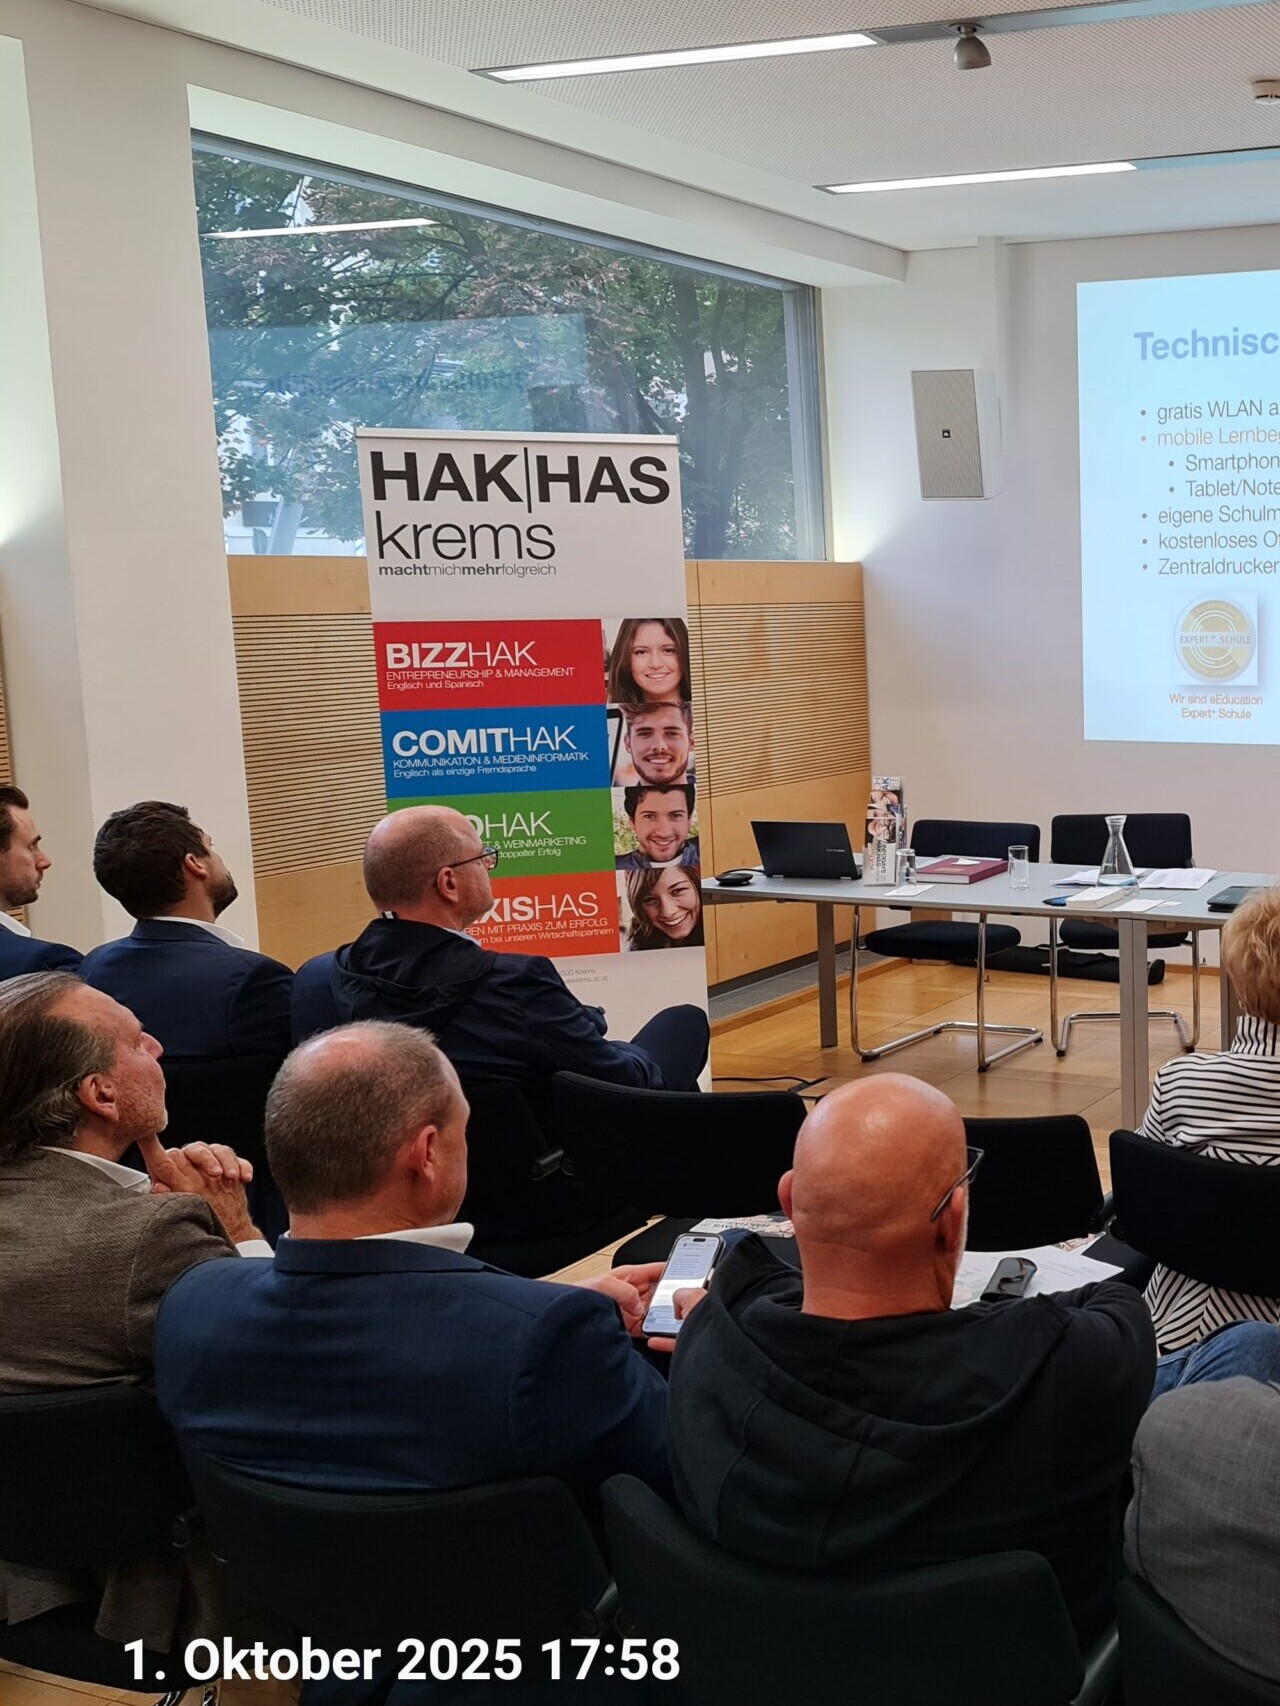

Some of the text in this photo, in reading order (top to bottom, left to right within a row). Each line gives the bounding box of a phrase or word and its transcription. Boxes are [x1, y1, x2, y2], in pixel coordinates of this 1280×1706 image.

[1157, 403, 1202, 424] gratis
[1208, 399, 1263, 418] WLAN
[1157, 427, 1213, 447] mobile
[1158, 505, 1214, 527] eigene
[375, 510, 556, 560] krems
[1159, 530, 1258, 550] kostenloses
[378, 564, 557, 578] machtmichmehrfolgreich
[1159, 556, 1280, 576] Zentraldrucker
[1180, 635, 1208, 644] EXPERT
[1219, 635, 1251, 644] SCHULE
[386, 641, 538, 669] BIZZHAK
[386, 667, 575, 681] ENTREPRENEURSHIP & MANAGEMENT
[387, 680, 484, 691] Englisch und Spanisch
[1169, 694, 1263, 705] Wir sind eEducation
[1218, 708, 1251, 719] Schule
[392, 725, 577, 757] COMITHAK
[393, 752, 589, 768] KOMMUNIKATION & MEDIENINFORMATIK
[394, 765, 537, 779] Englisch als einzige Fremdsprache
[503, 836, 587, 849] WEINMARKETING
[538, 848, 561, 857] Erfolg
[473, 892, 599, 924] XISHAS
[488, 925, 504, 934] MIT
[507, 923, 543, 933] PRAXIS
[545, 920, 567, 930] ZUM
[569, 918, 608, 928] ERFOLG
[490, 935, 503, 943] bei
[504, 932, 537, 942] unseren
[538, 928, 614, 940] Wirtschaftspartnern
